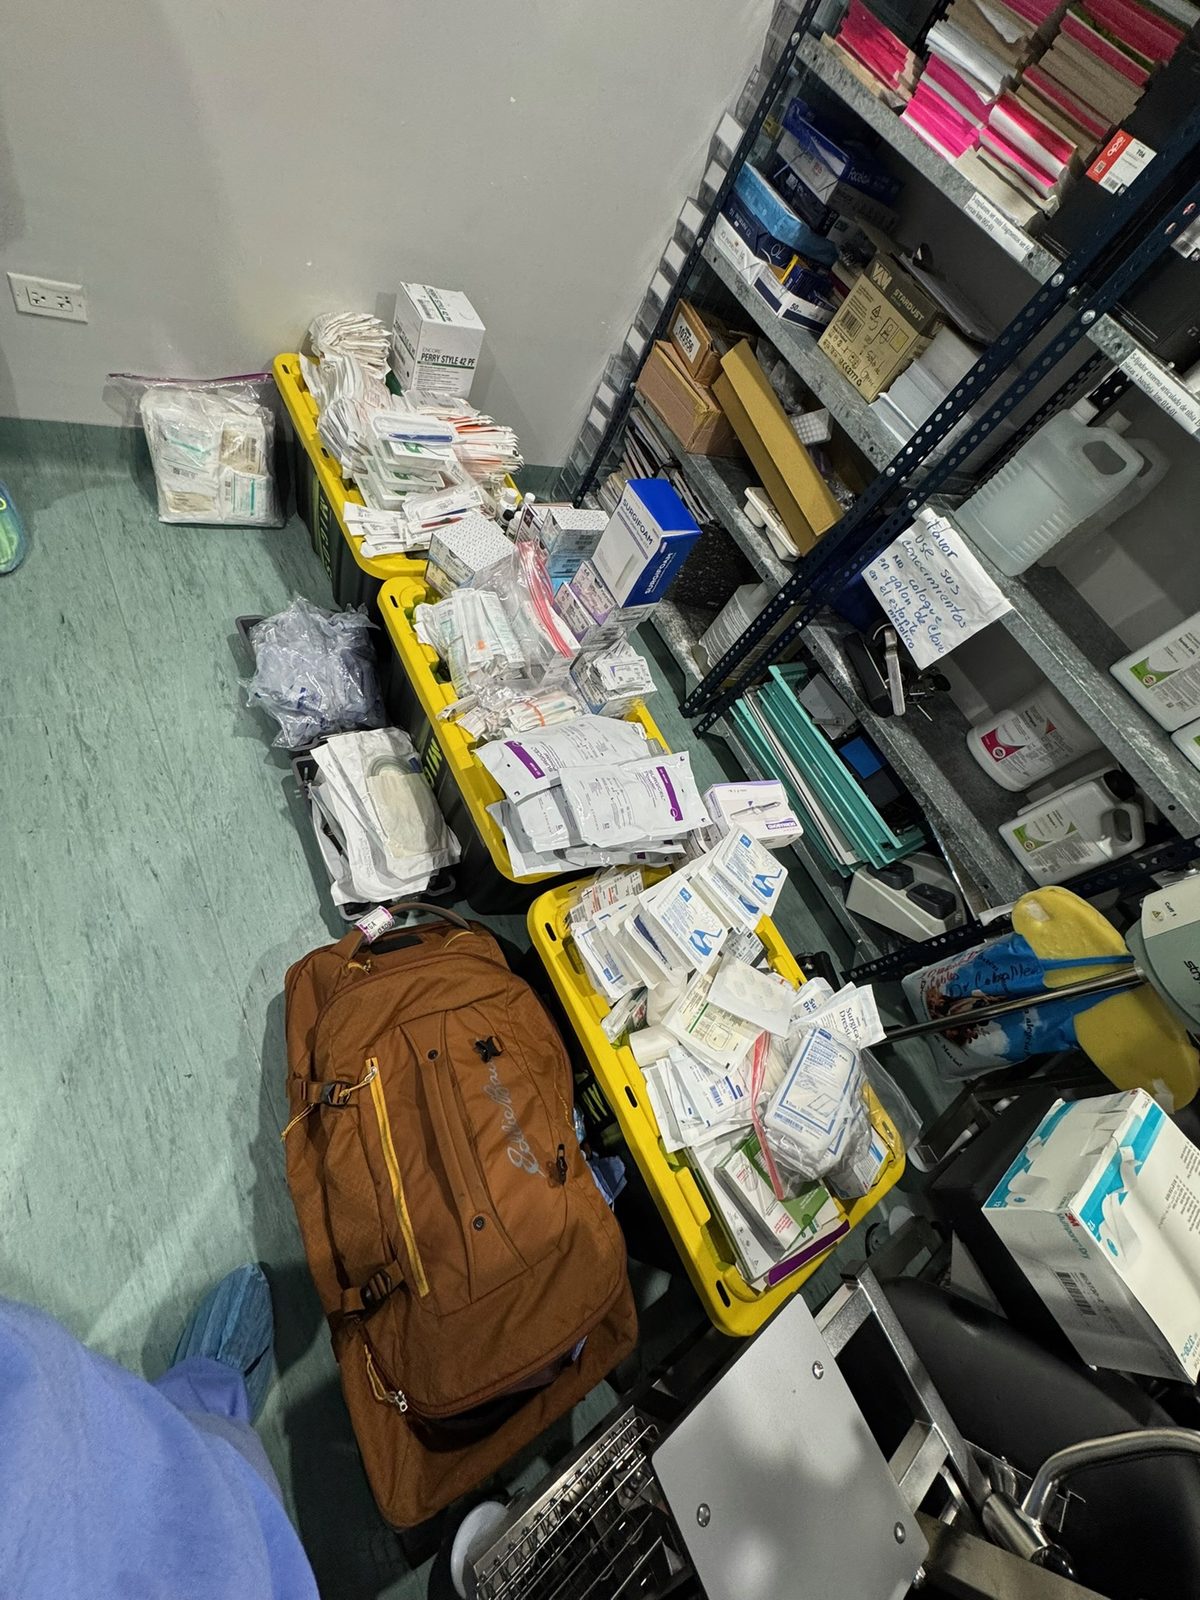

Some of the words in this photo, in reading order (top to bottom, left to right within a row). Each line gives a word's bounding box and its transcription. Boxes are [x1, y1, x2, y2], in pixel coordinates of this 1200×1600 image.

[789, 301, 799, 311] 50
[890, 288, 927, 322] STARDUST
[420, 352, 440, 361] PERRY
[440, 355, 458, 364] STYLE
[459, 357, 466, 365] 42
[467, 358, 475, 366] PF
[620, 497, 654, 545] SURGIFOAM
[642, 550, 674, 595] SURGIFOAM
[1064, 1209, 1080, 1229] 3M
[1086, 1218, 1097, 1231] 12
